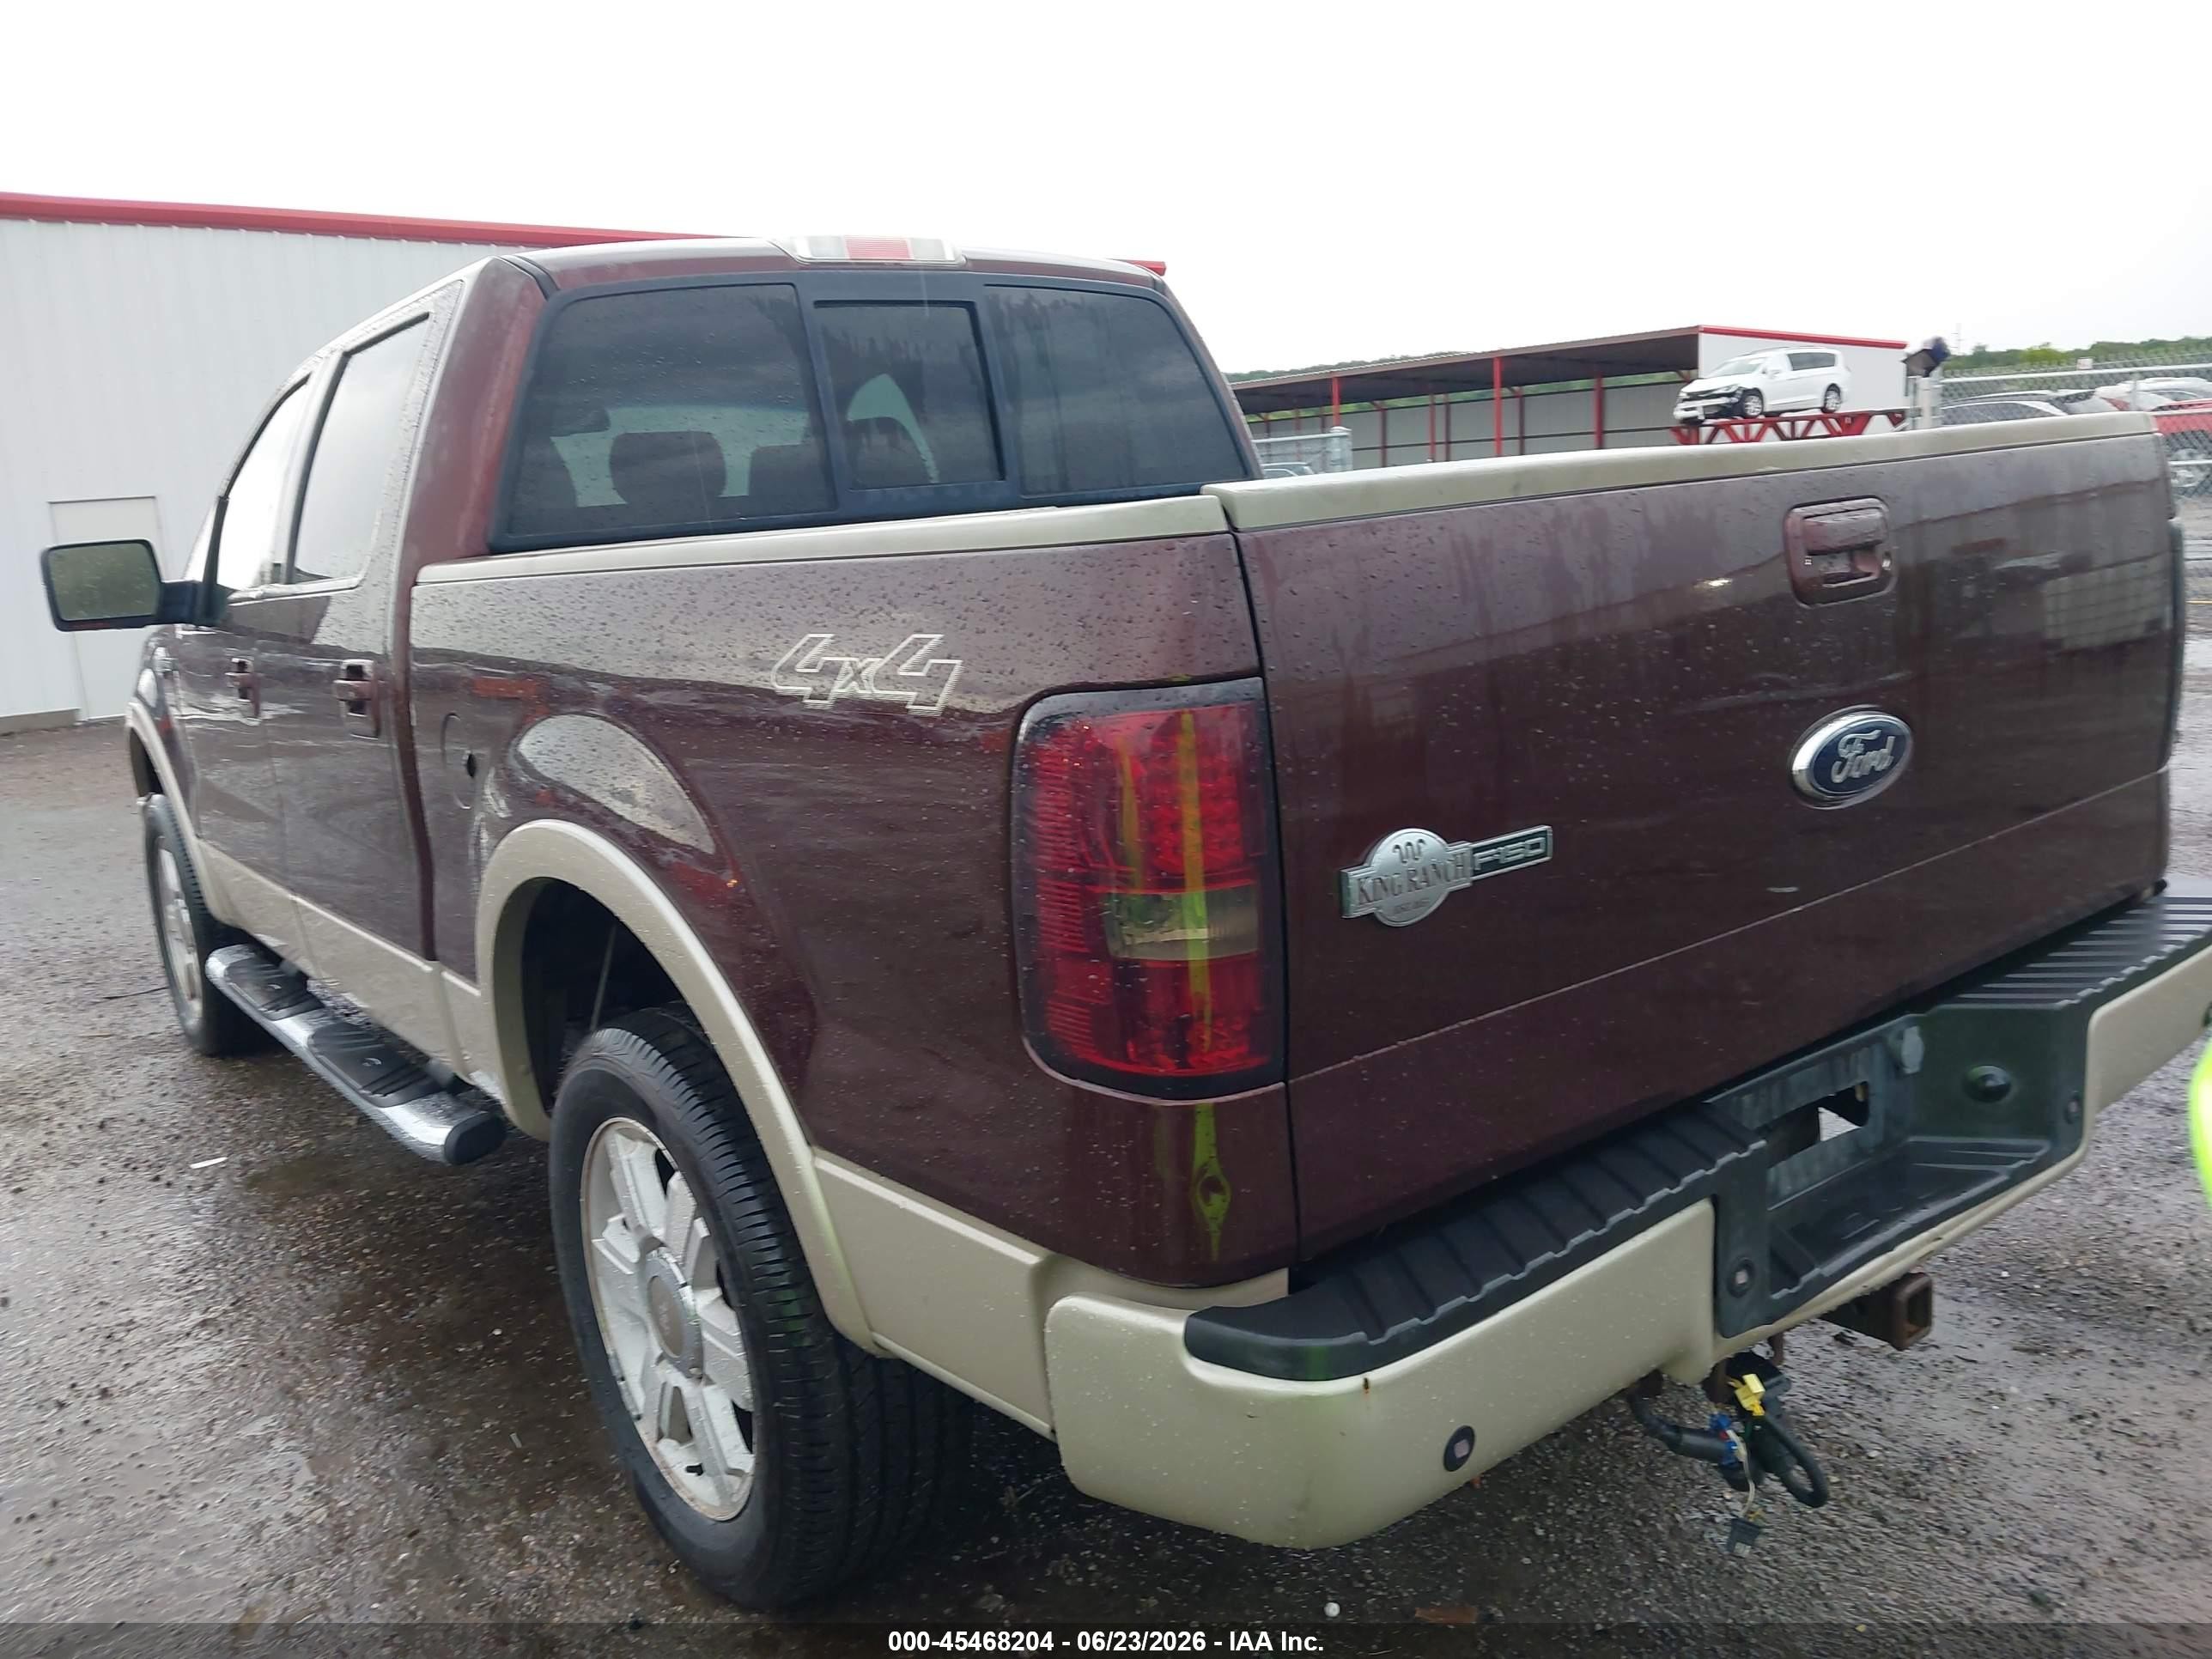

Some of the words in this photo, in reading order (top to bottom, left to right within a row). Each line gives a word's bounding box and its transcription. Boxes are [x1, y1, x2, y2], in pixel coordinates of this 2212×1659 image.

[1831, 730, 1896, 783] Ford
[1357, 872, 1403, 906] KING
[1407, 850, 1472, 892] RANCH
